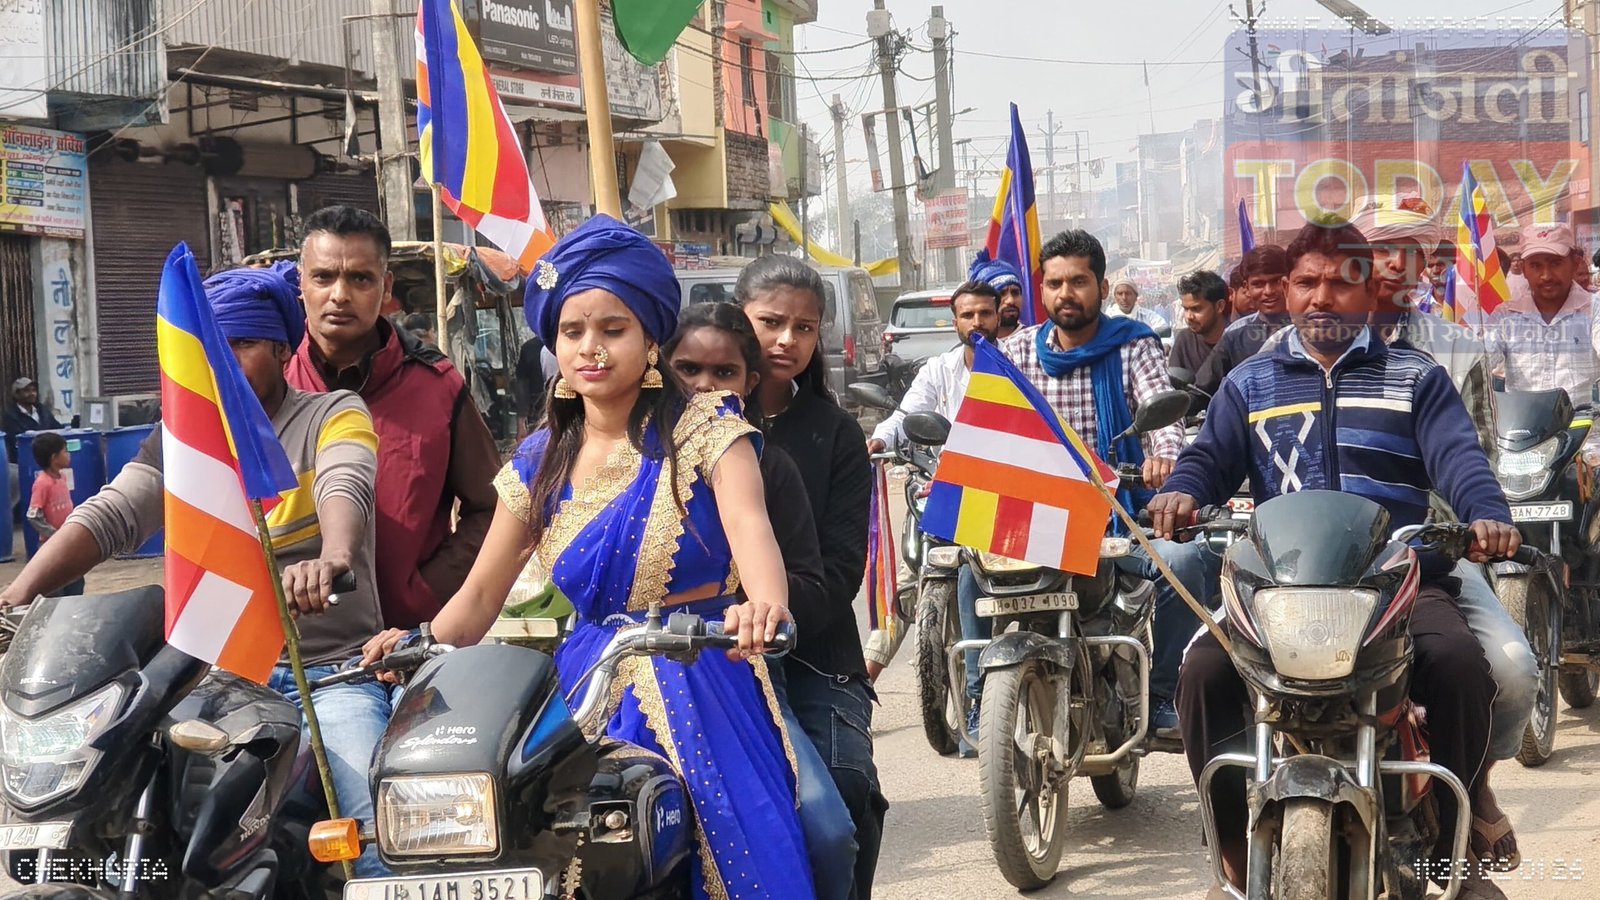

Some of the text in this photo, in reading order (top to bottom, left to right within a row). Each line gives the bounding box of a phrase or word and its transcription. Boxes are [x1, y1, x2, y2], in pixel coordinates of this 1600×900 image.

[481, 0, 540, 31] Panasonic
[1537, 506, 1567, 517] 7748
[990, 600, 1003, 613] JH
[447, 726, 476, 735] Hero
[665, 808, 681, 826] Hero
[418, 881, 459, 900] 14M
[471, 875, 529, 900] 3521
